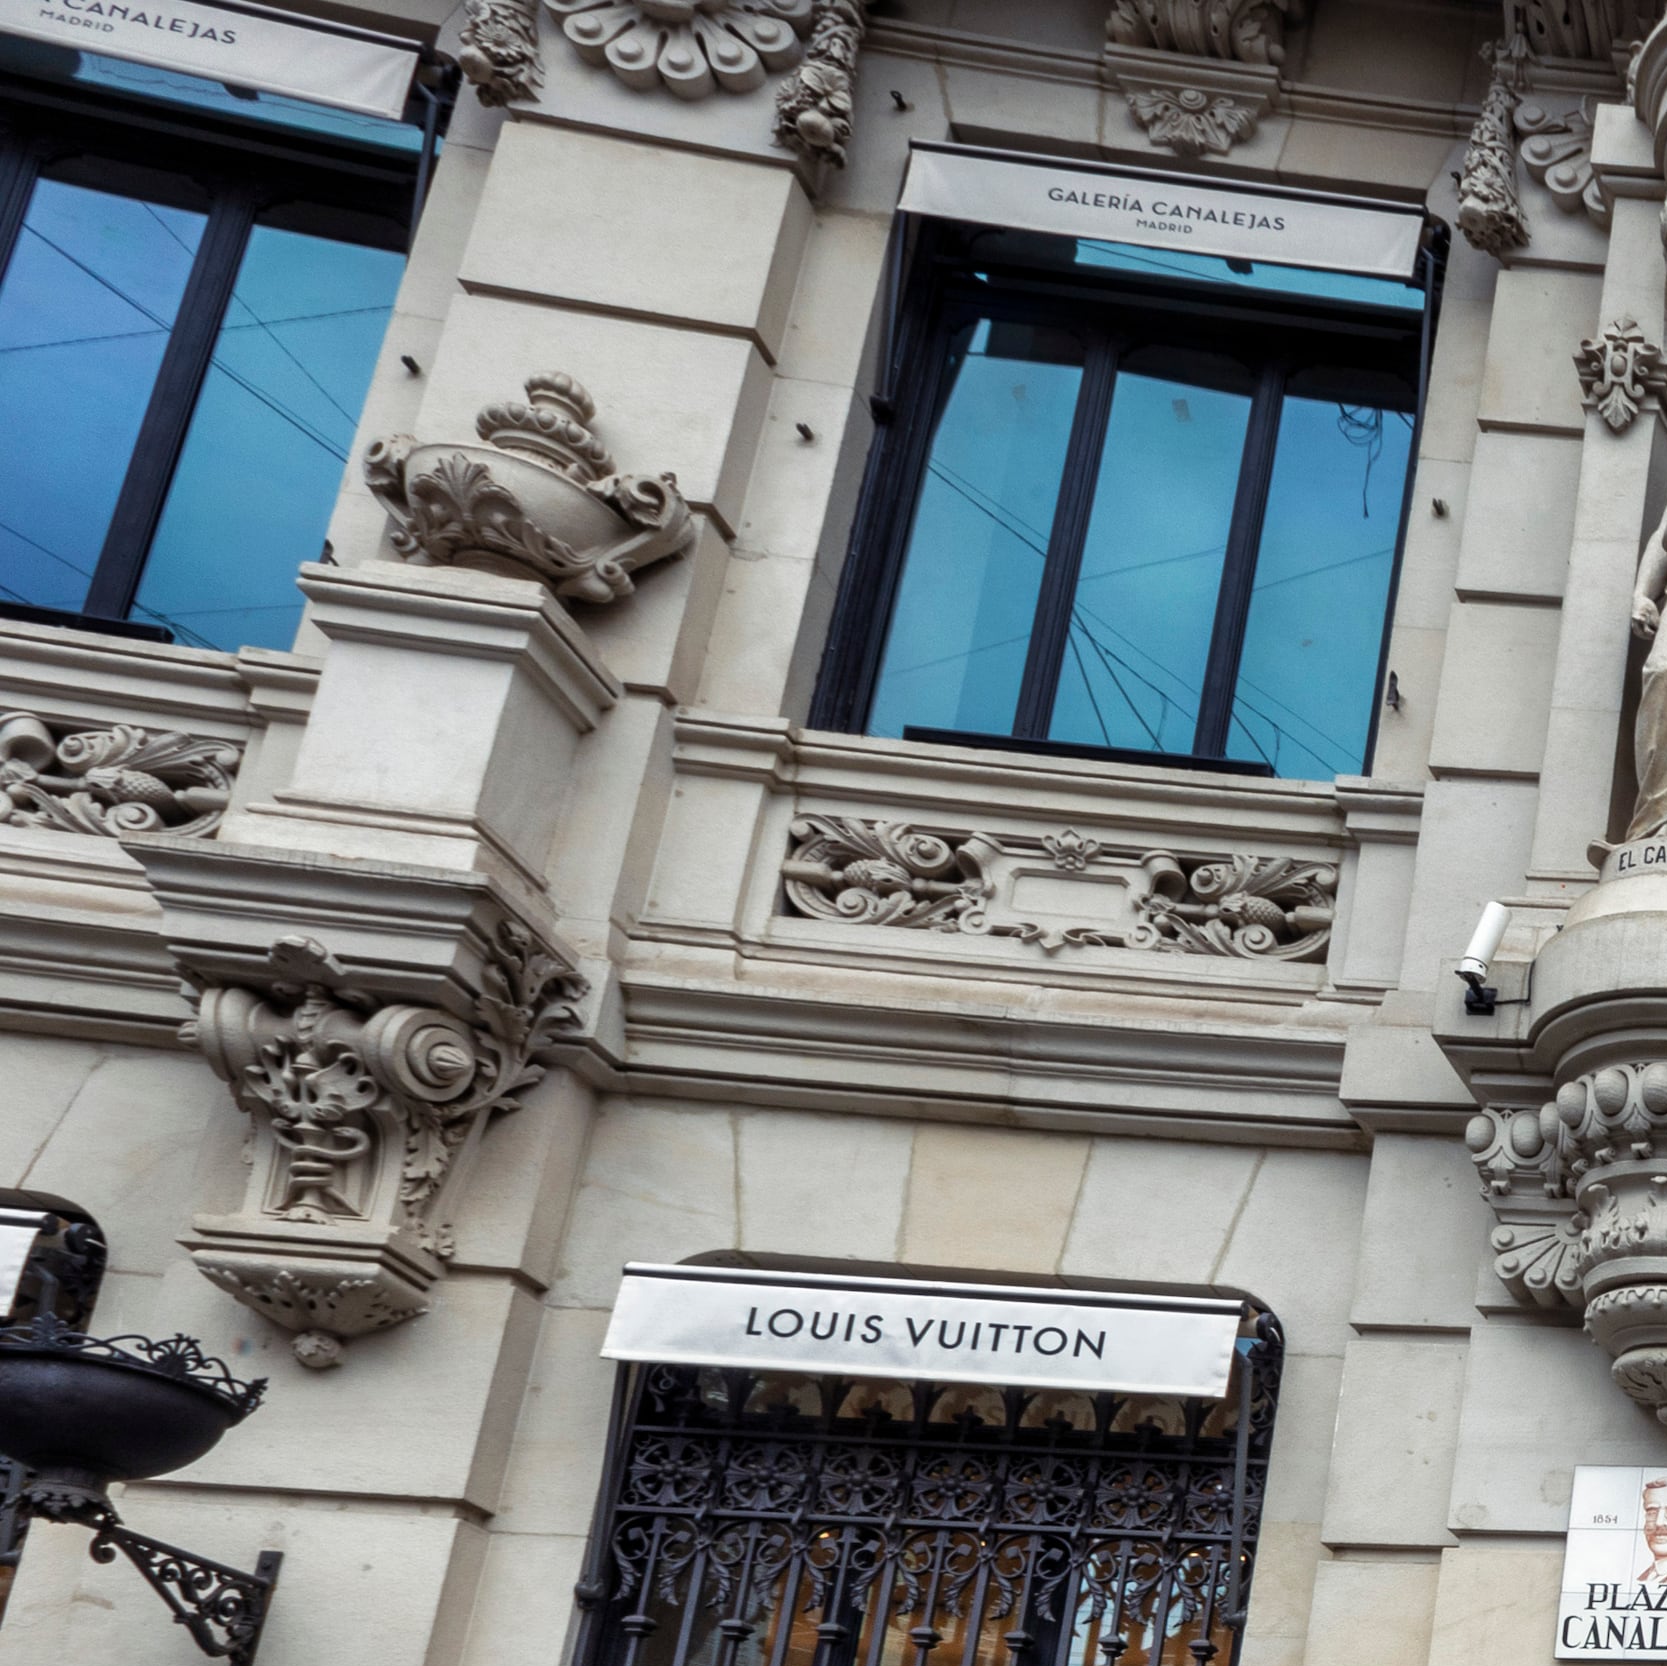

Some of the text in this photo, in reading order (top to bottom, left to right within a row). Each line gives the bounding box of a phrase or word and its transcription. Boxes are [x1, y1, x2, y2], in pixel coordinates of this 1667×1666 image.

[39, 9, 115, 34] MADRID
[1047, 186, 1286, 231] GALERÍA CANALEJAS
[1136, 218, 1193, 235] MADRID
[1618, 851, 1637, 872] EL
[745, 1307, 1107, 1360] LOUIS VUITTON
